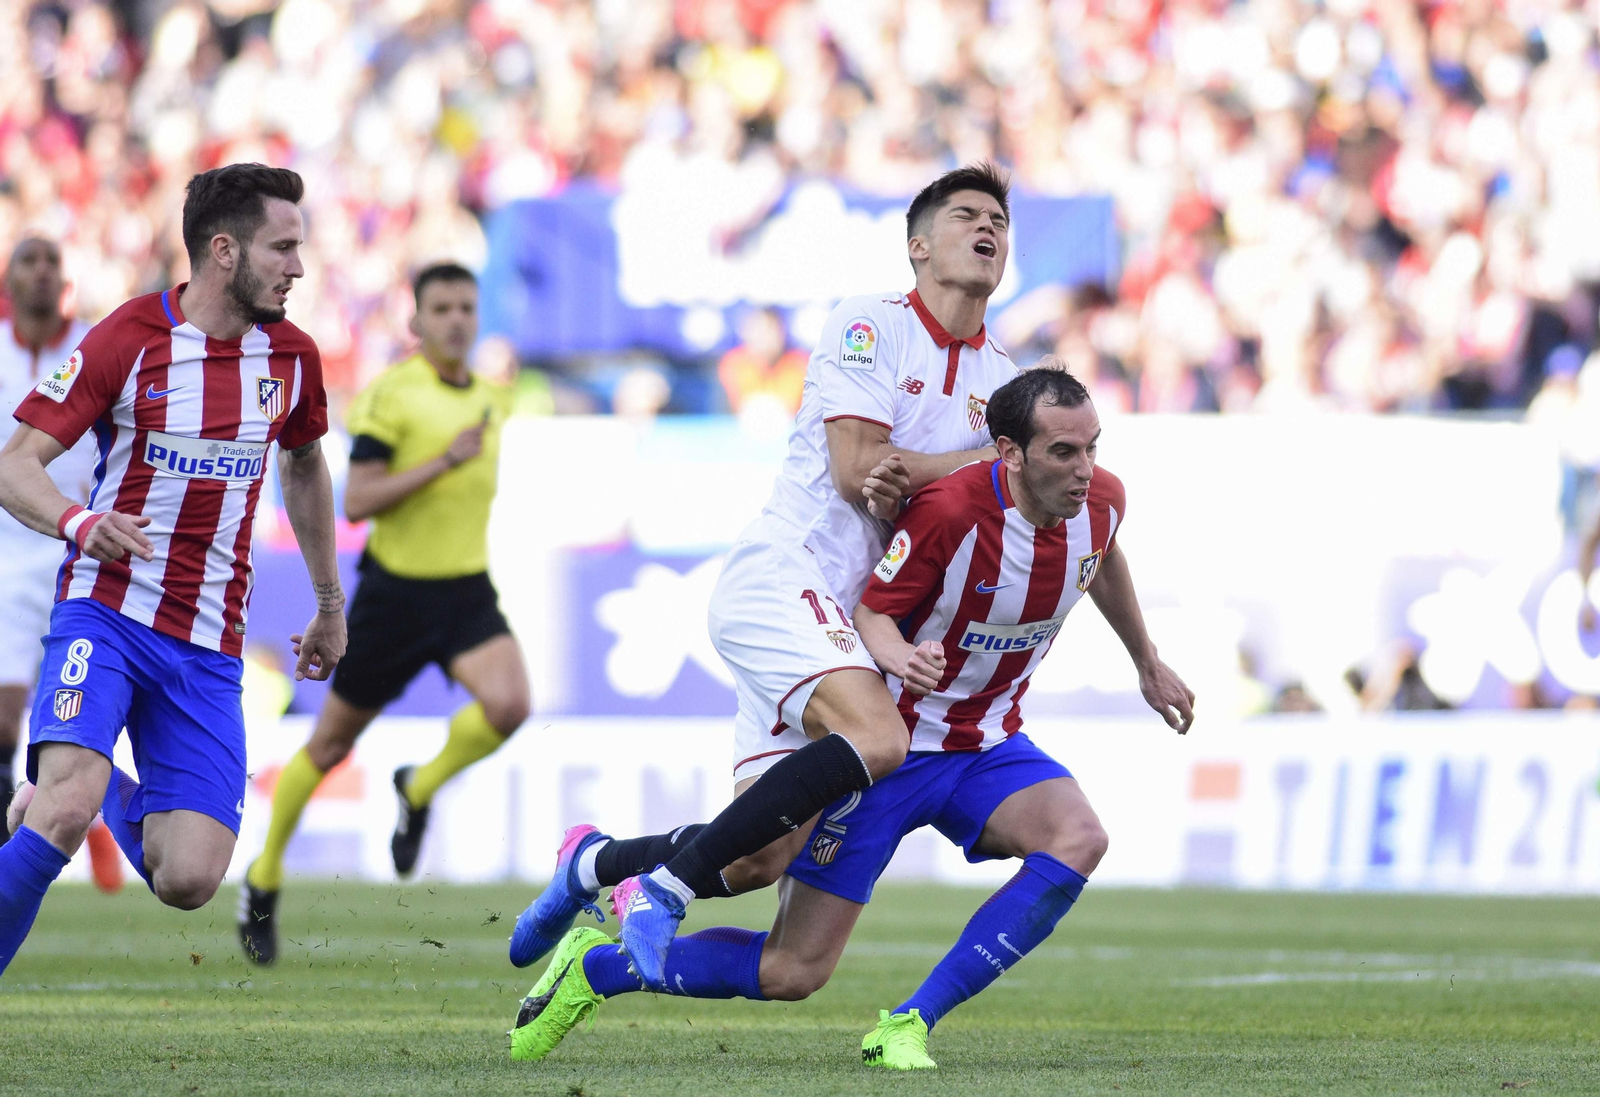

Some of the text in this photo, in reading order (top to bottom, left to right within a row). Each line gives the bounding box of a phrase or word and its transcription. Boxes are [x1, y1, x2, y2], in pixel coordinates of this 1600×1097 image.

[842, 353, 873, 365] LaLiga
[147, 442, 263, 478] Plus500
[222, 446, 246, 456] Trade
[962, 623, 1062, 651] Plus50
[60, 638, 93, 686] 8
[823, 790, 863, 835] 2
